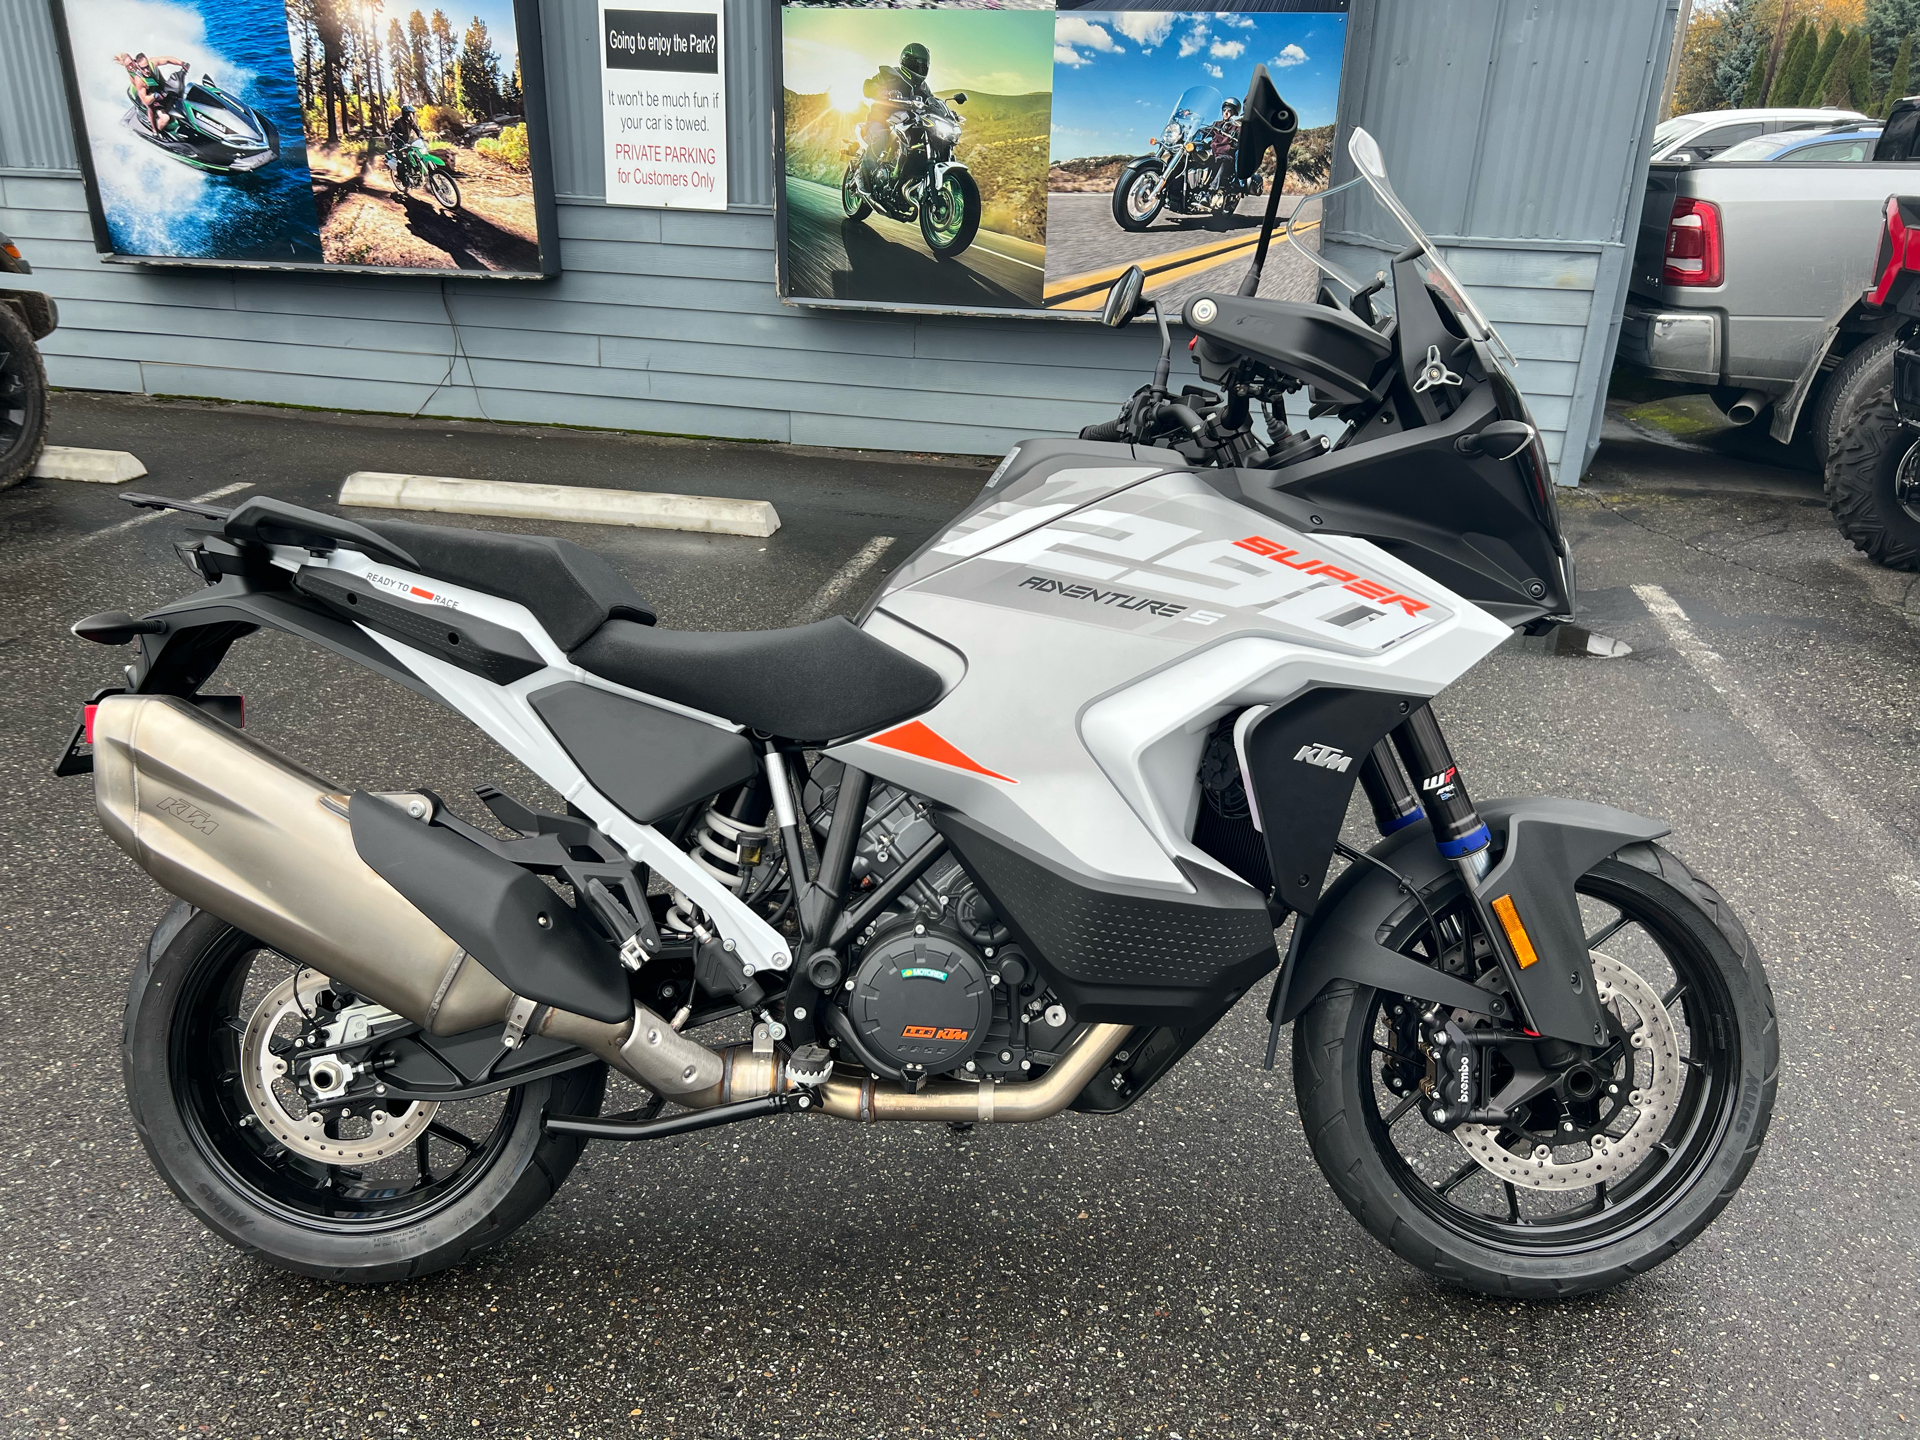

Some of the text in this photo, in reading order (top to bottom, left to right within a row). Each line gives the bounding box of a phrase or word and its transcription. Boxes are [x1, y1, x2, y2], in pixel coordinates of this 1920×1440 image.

[609, 29, 716, 56] Going to enjoy the Park?
[608, 90, 719, 108] It won't be much fun if
[620, 115, 710, 133] your car is towed.
[615, 143, 716, 165] PRIVATE PARKING
[617, 167, 715, 193] for Customers Only
[1231, 535, 1431, 618] SUPER
[365, 572, 459, 610] READY TO RACE
[1017, 576, 1227, 626] ADVENTURE S
[1293, 742, 1353, 773] KTM
[1423, 766, 1455, 791] WP
[156, 796, 219, 836] KTM
[935, 1027, 968, 1041] KTM
[1458, 1056, 1469, 1103] brembo
